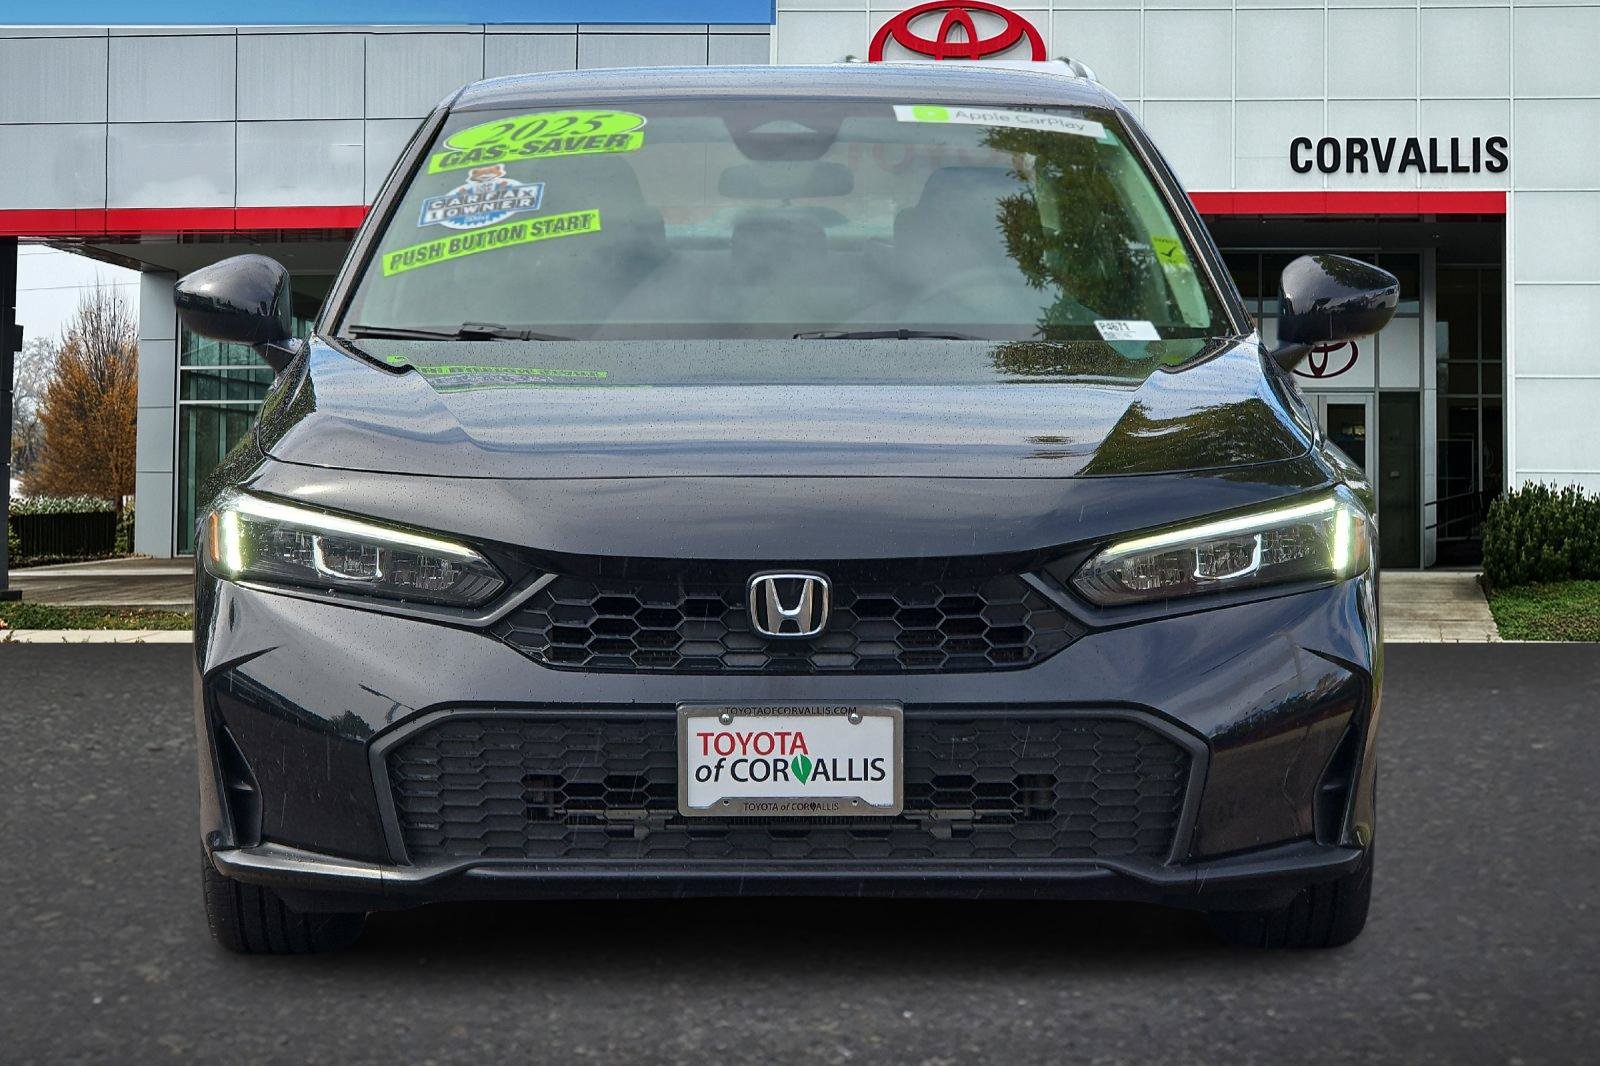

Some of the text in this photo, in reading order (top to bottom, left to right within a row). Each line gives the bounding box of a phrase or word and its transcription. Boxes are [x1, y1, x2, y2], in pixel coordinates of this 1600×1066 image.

[476, 114, 615, 146] 2025
[955, 110, 1086, 131] Apple CarPlay
[438, 133, 630, 169] GAS-SAVER
[1289, 137, 1509, 174] CORVALLIS
[430, 188, 534, 209] CARFAX
[446, 198, 535, 218] OWNER
[390, 213, 593, 271] PUSH BUTTON START
[725, 706, 857, 716] TOYOTAOFCORVALLIS.COM
[696, 731, 809, 756] TOYOTA
[695, 757, 726, 783] of
[744, 802, 779, 811] TOYOTA
[781, 802, 791, 811] of
